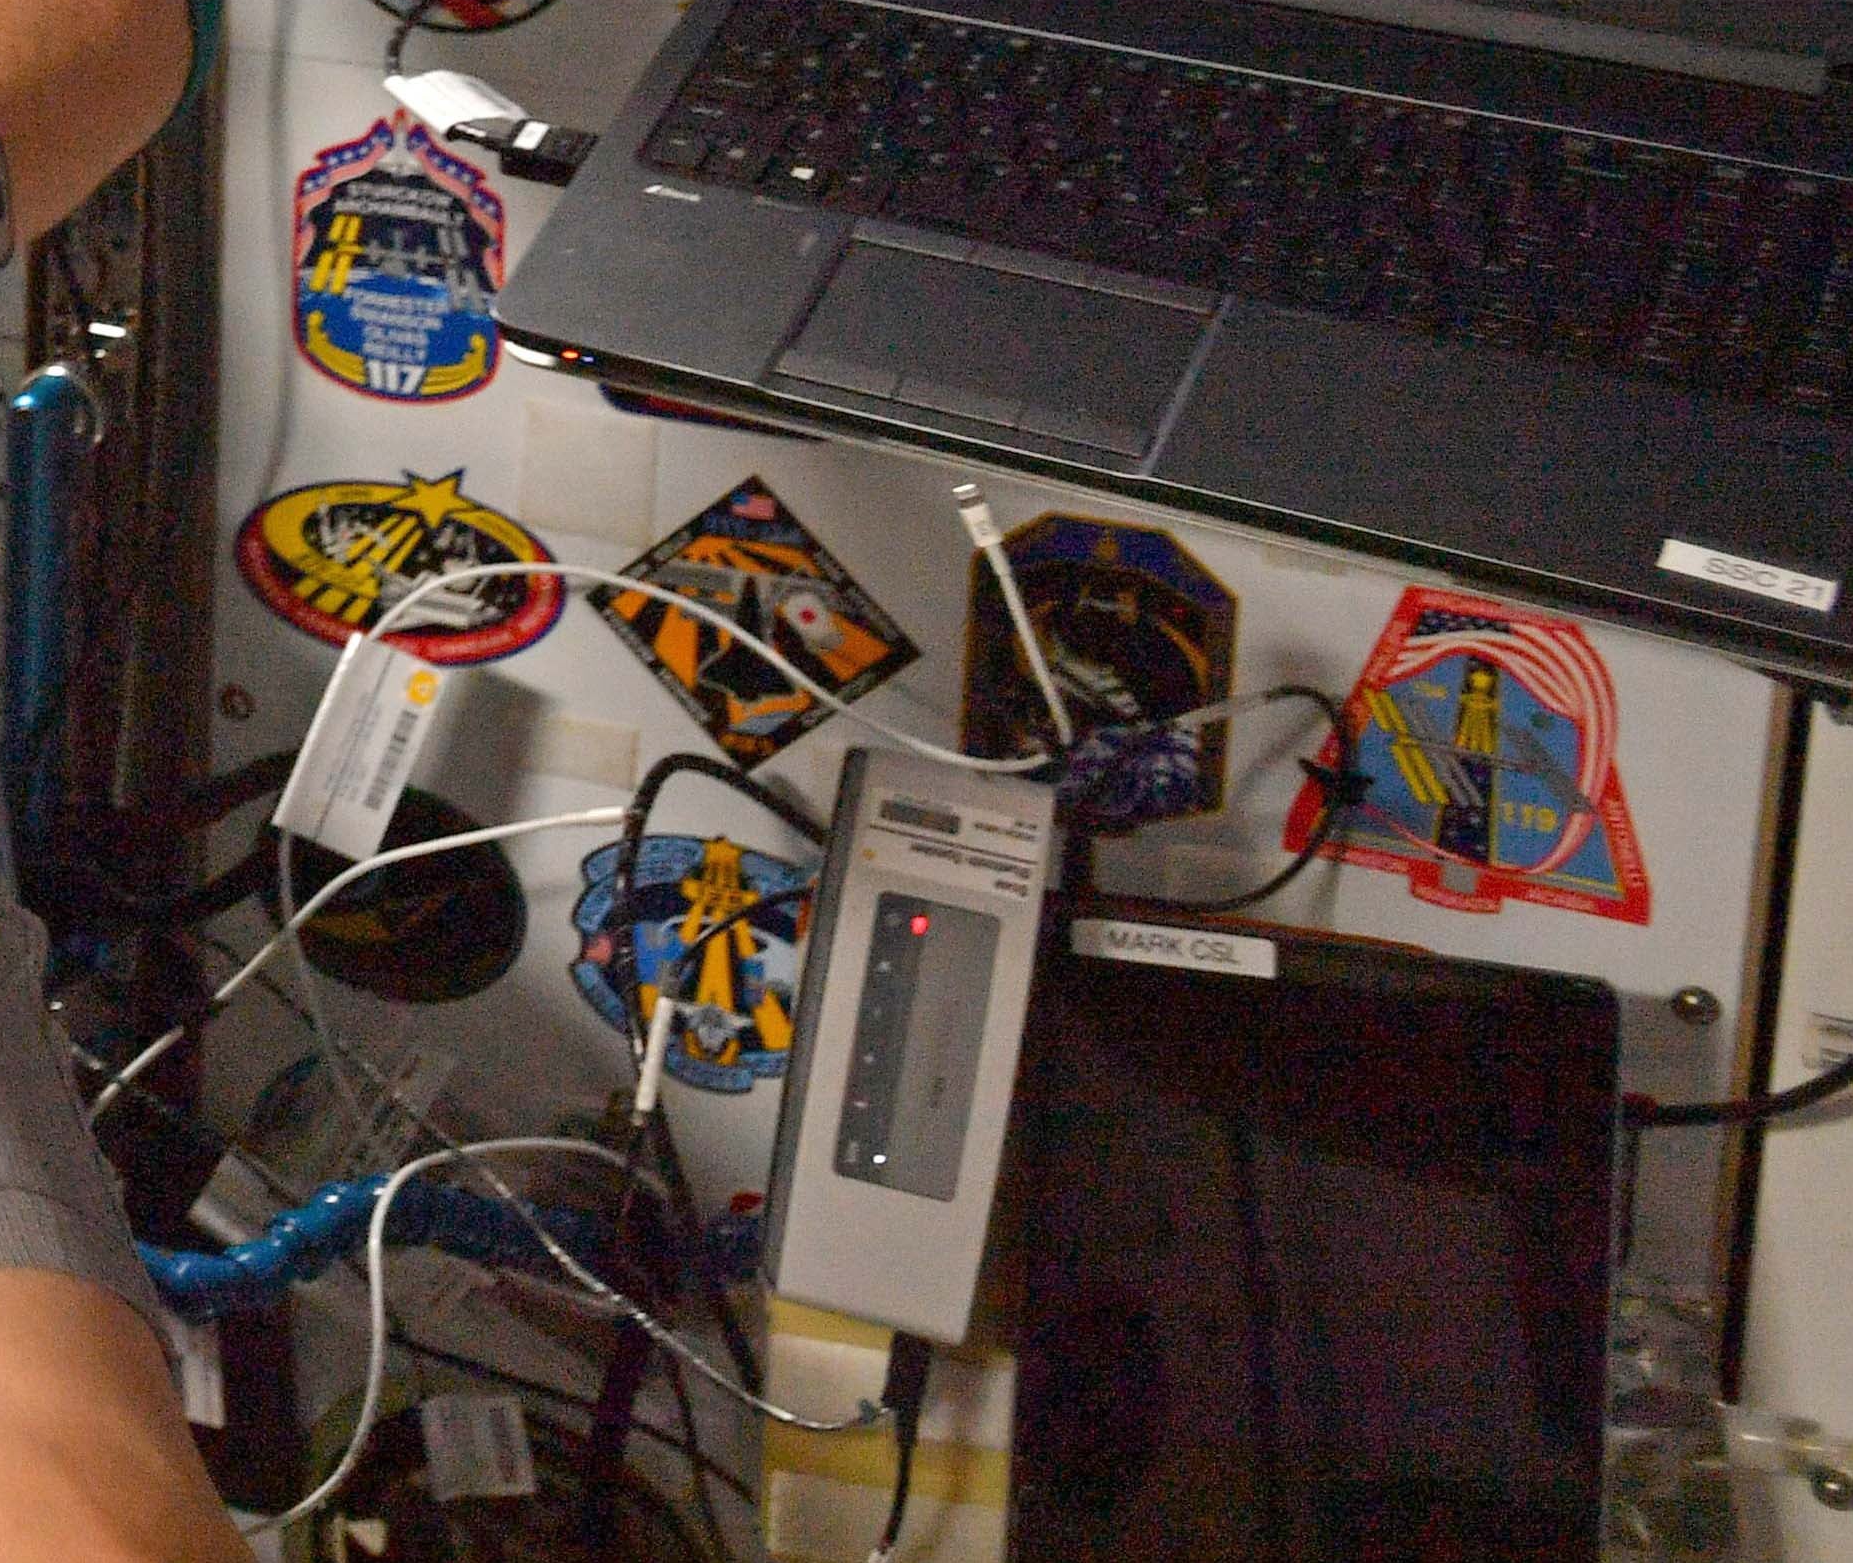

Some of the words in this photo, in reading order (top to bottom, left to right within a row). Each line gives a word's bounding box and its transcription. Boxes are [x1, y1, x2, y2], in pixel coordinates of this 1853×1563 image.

[366, 358, 427, 395] 117
[1703, 557, 1780, 588] SSC
[1784, 578, 1826, 601] 21
[1104, 927, 1184, 957] MARK
[1190, 938, 1243, 966] CSL
